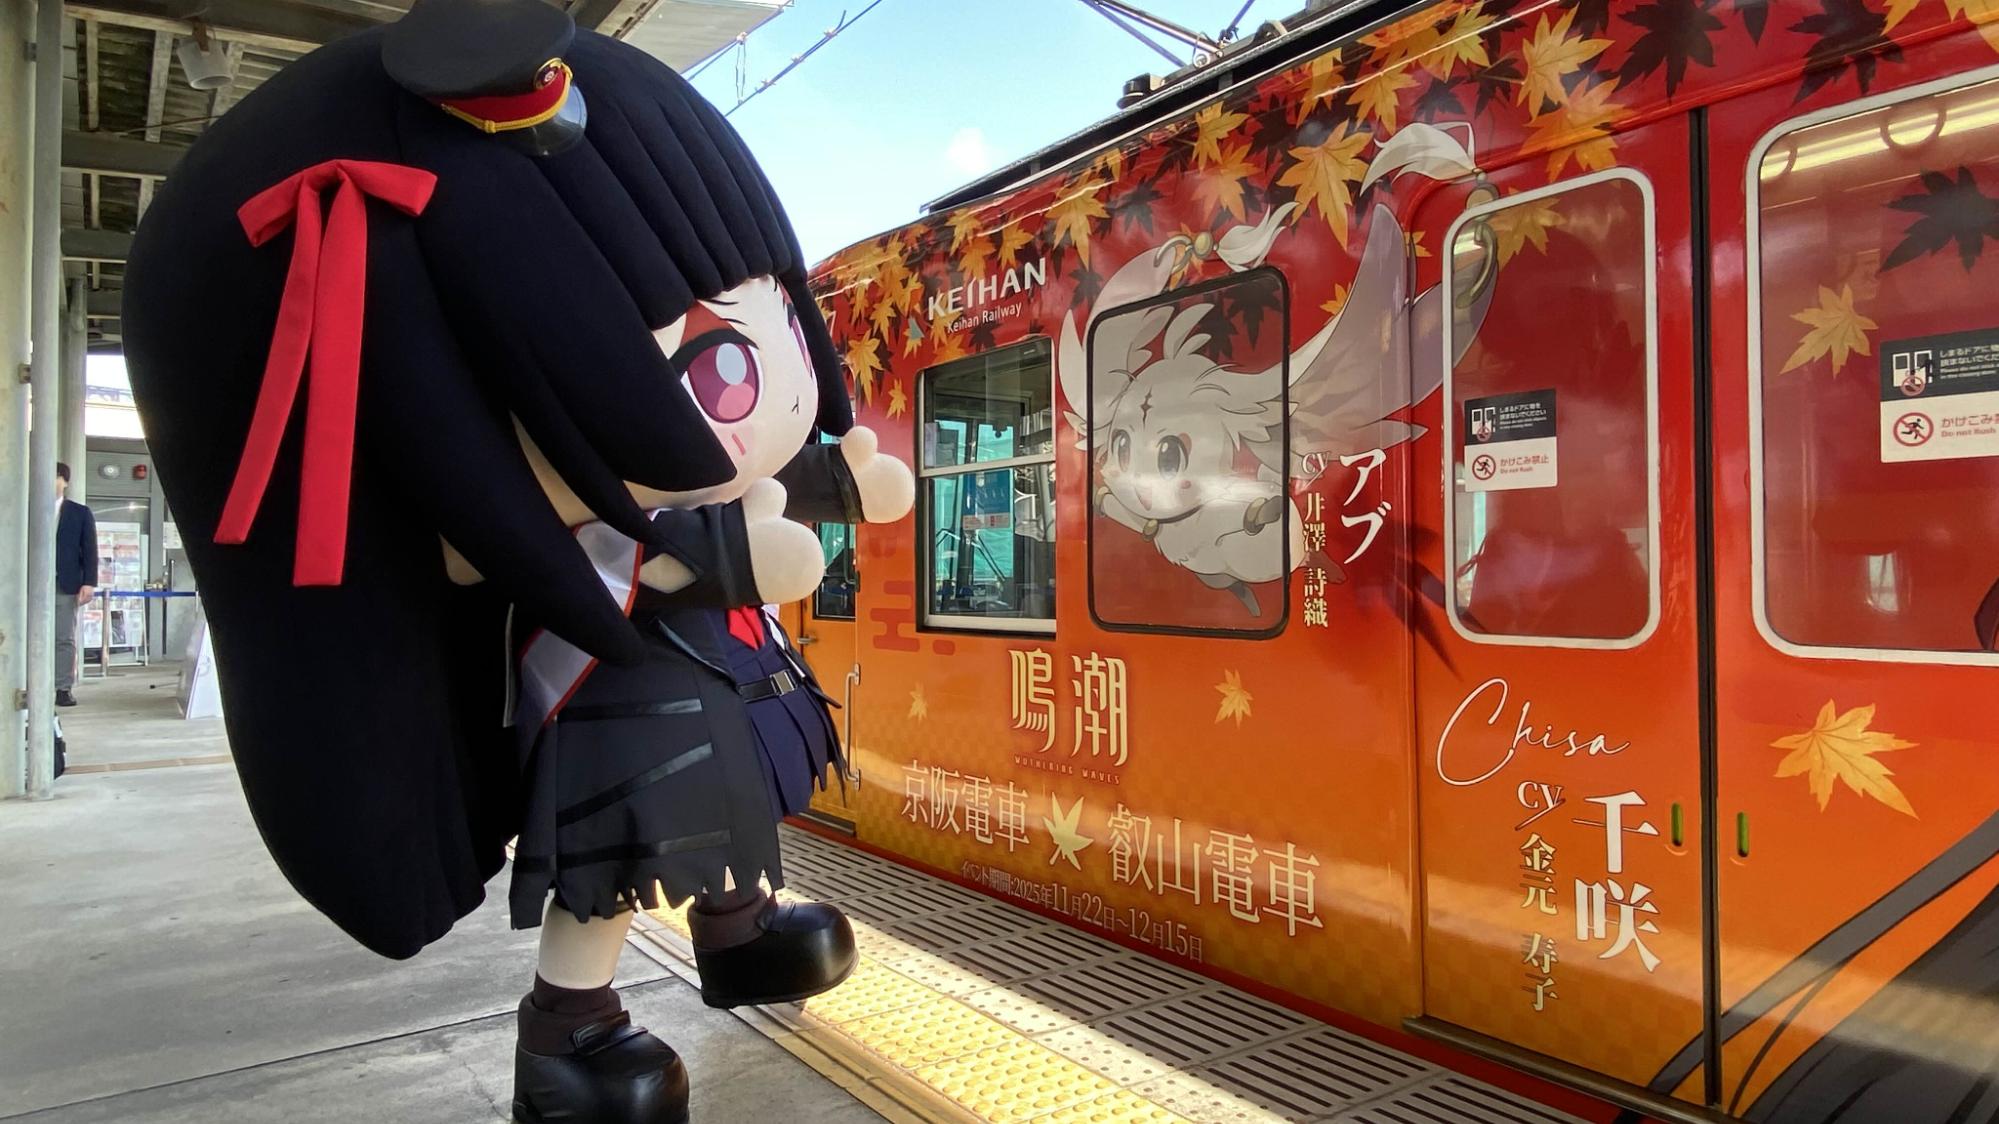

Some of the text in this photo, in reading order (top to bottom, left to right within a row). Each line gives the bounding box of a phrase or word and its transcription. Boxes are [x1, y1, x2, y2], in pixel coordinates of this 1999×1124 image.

[928, 257, 1046, 322] KEIHAN
[947, 302, 1022, 334] Keihan Railway
[1340, 448, 1392, 564] アブ
[1008, 648, 1128, 767] 鳴潮
[1437, 678, 1630, 786] Chisa
[1082, 768, 1120, 785] WAVES
[901, 759, 1323, 937] 京阪電車 叡山電車
[1572, 791, 1661, 972] 千咲
[1519, 832, 1559, 1011] 金元 寿子
